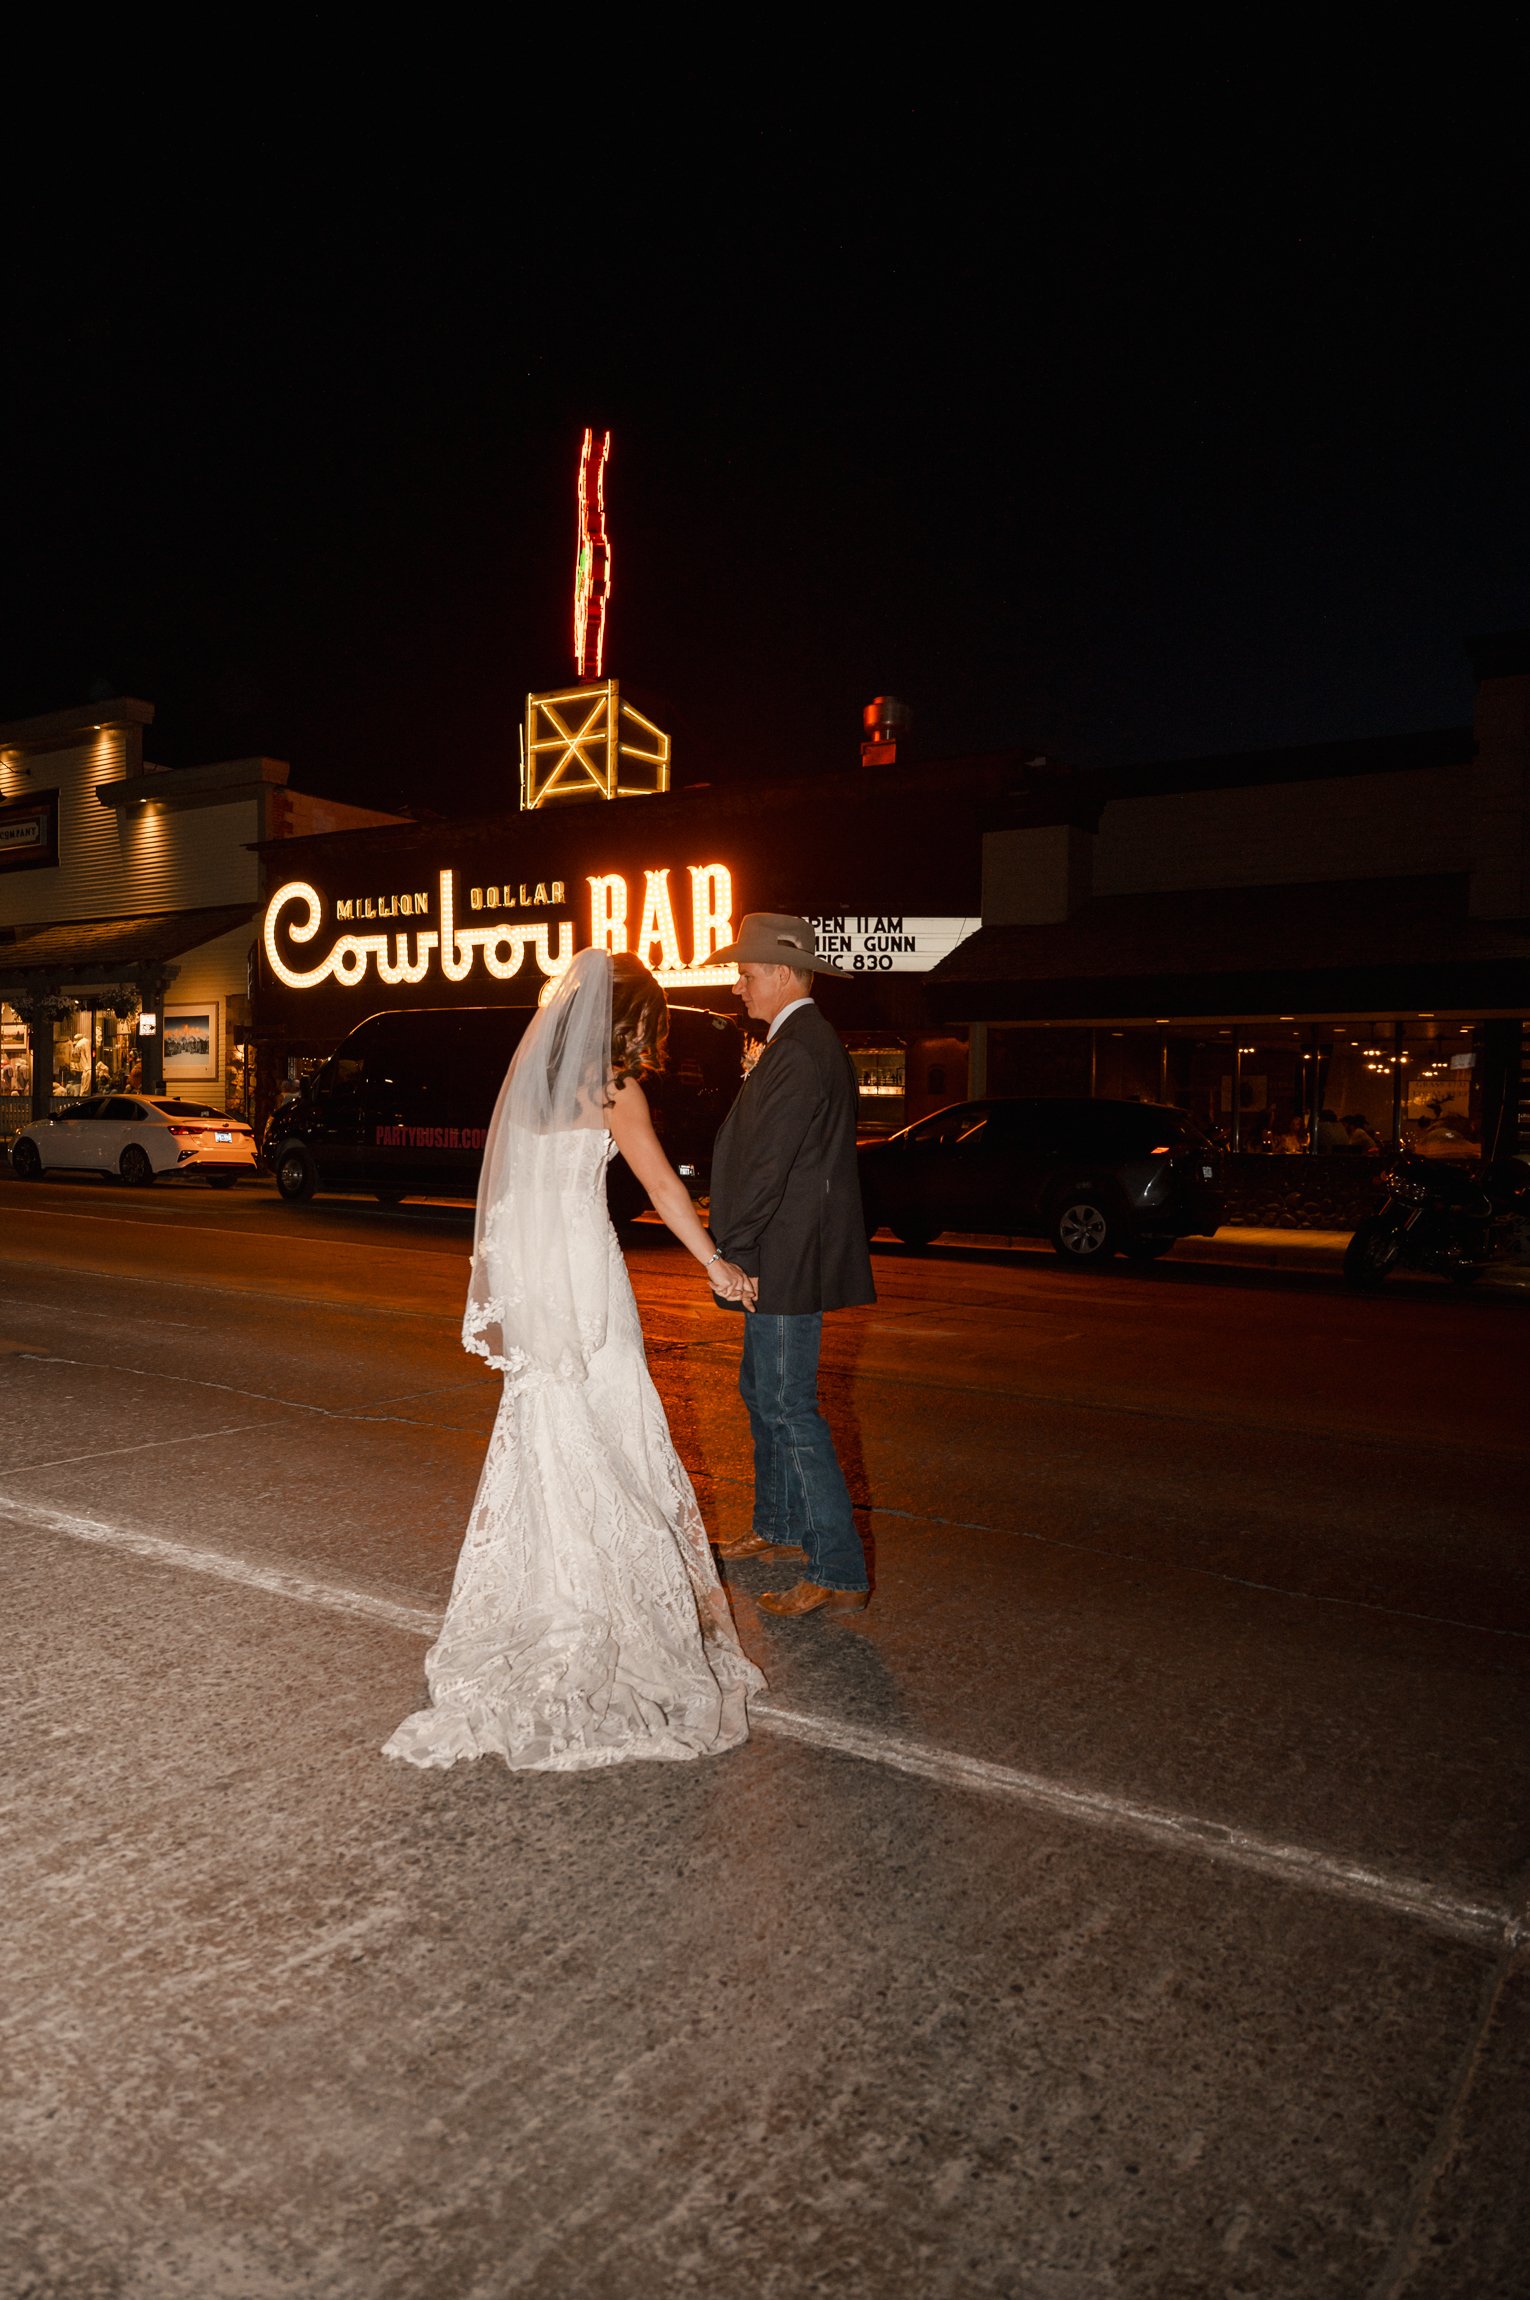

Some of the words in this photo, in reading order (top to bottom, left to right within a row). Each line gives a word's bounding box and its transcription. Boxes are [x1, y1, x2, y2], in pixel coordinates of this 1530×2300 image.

[336, 892, 429, 921] MILLION
[470, 881, 565, 910] DOLLAR
[806, 916, 845, 933] PEN
[264, 869, 575, 1006] Cowboy
[586, 863, 733, 970] BAR
[864, 936, 916, 952] GUNN
[817, 954, 844, 970] IC
[853, 954, 893, 970] 830
